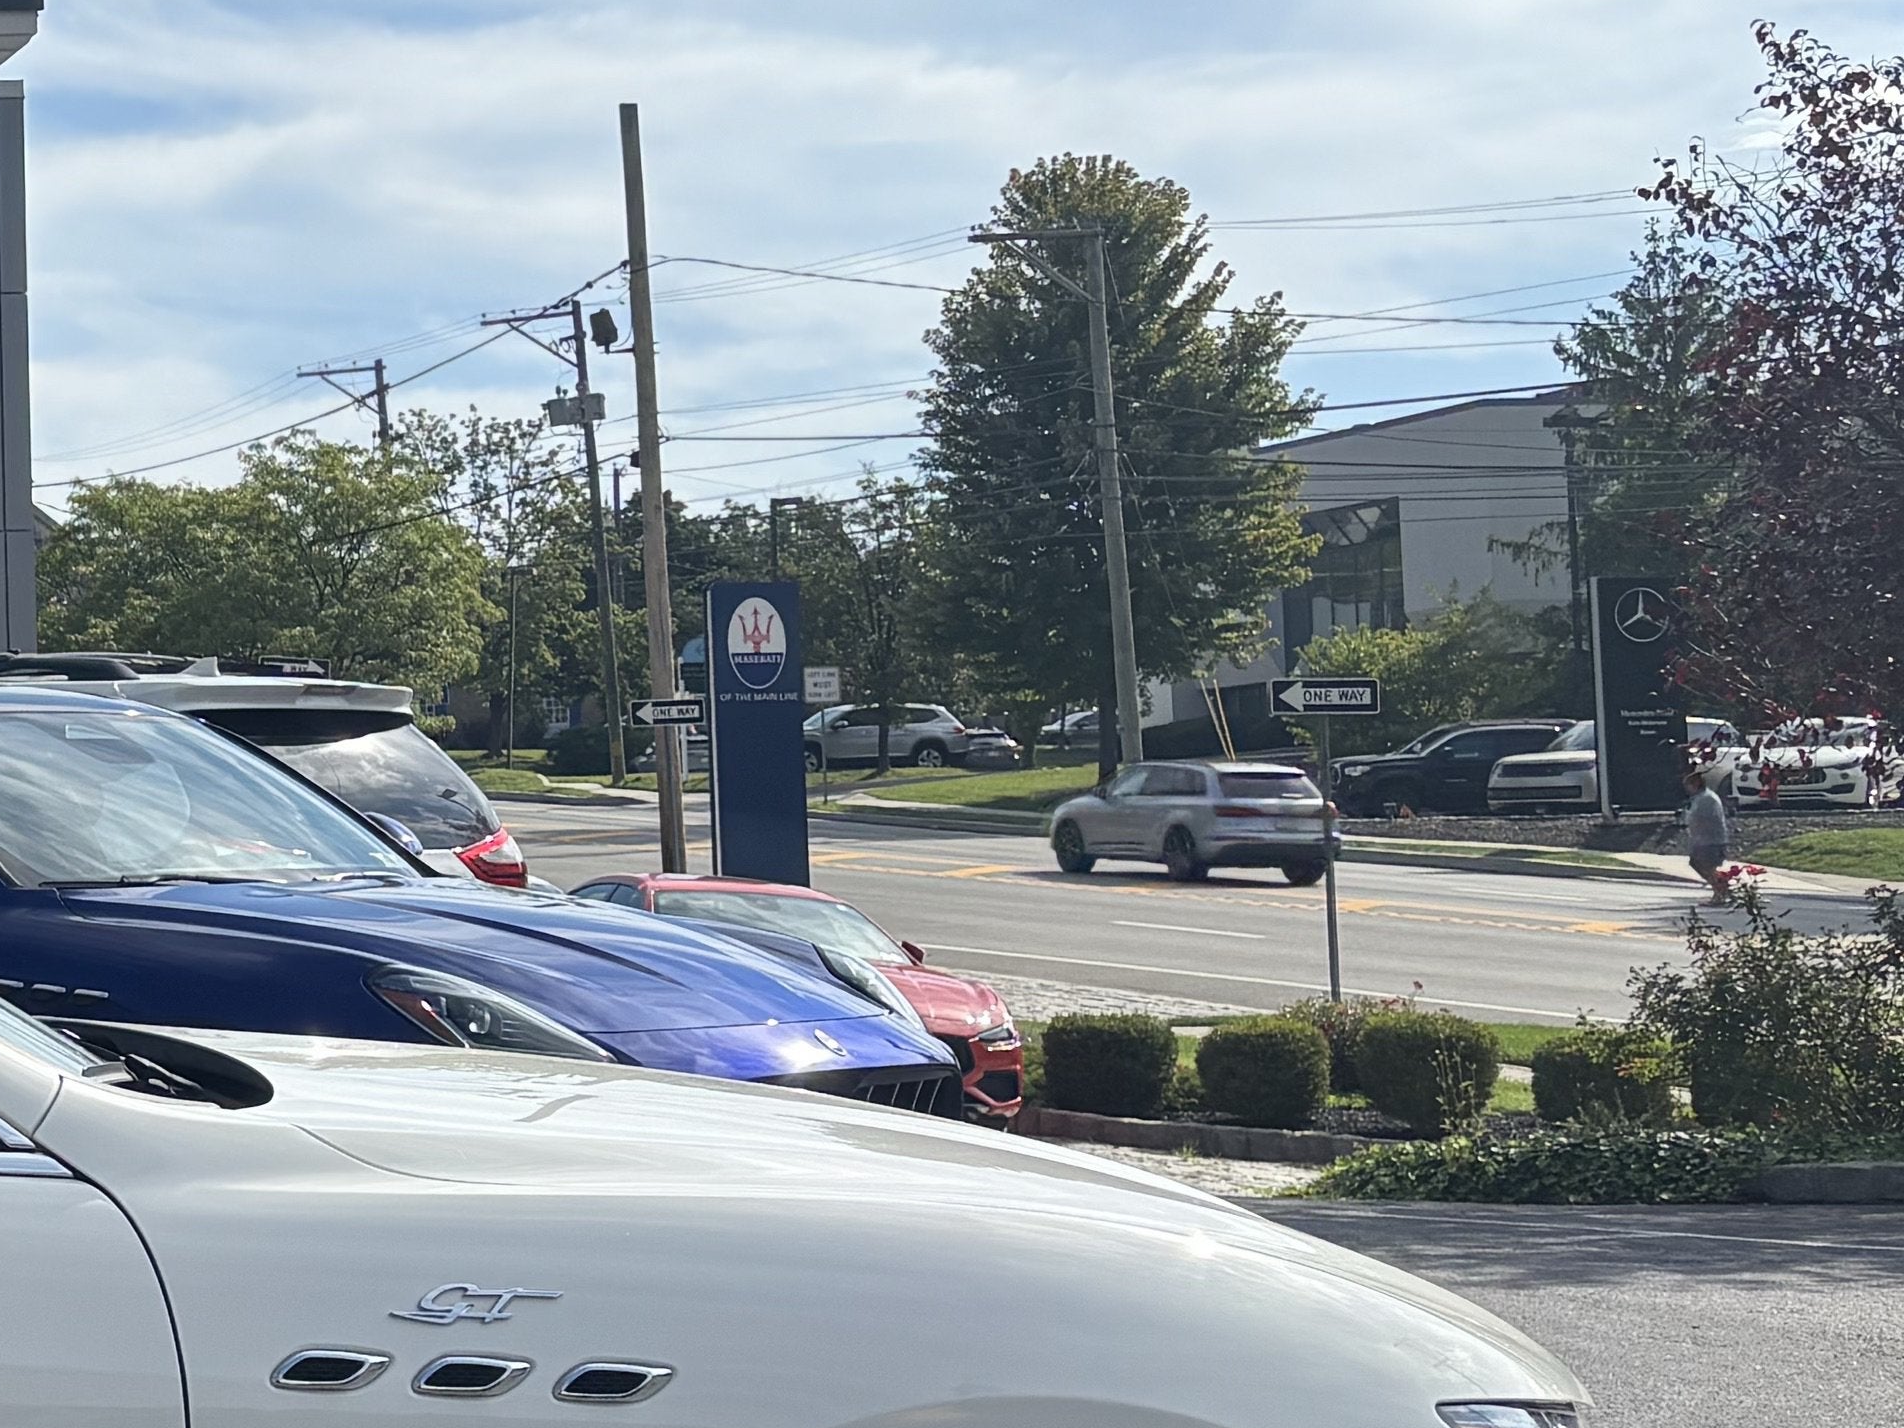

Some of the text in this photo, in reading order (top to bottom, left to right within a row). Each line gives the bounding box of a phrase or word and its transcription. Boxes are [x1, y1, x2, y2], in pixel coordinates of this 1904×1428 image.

[734, 655, 781, 663] MASERATI
[720, 692, 798, 701] OF THE MAIN LINE
[1304, 689, 1366, 702] ONE WAY
[652, 707, 696, 718] ONE WAY
[388, 1283, 565, 1325] GT
